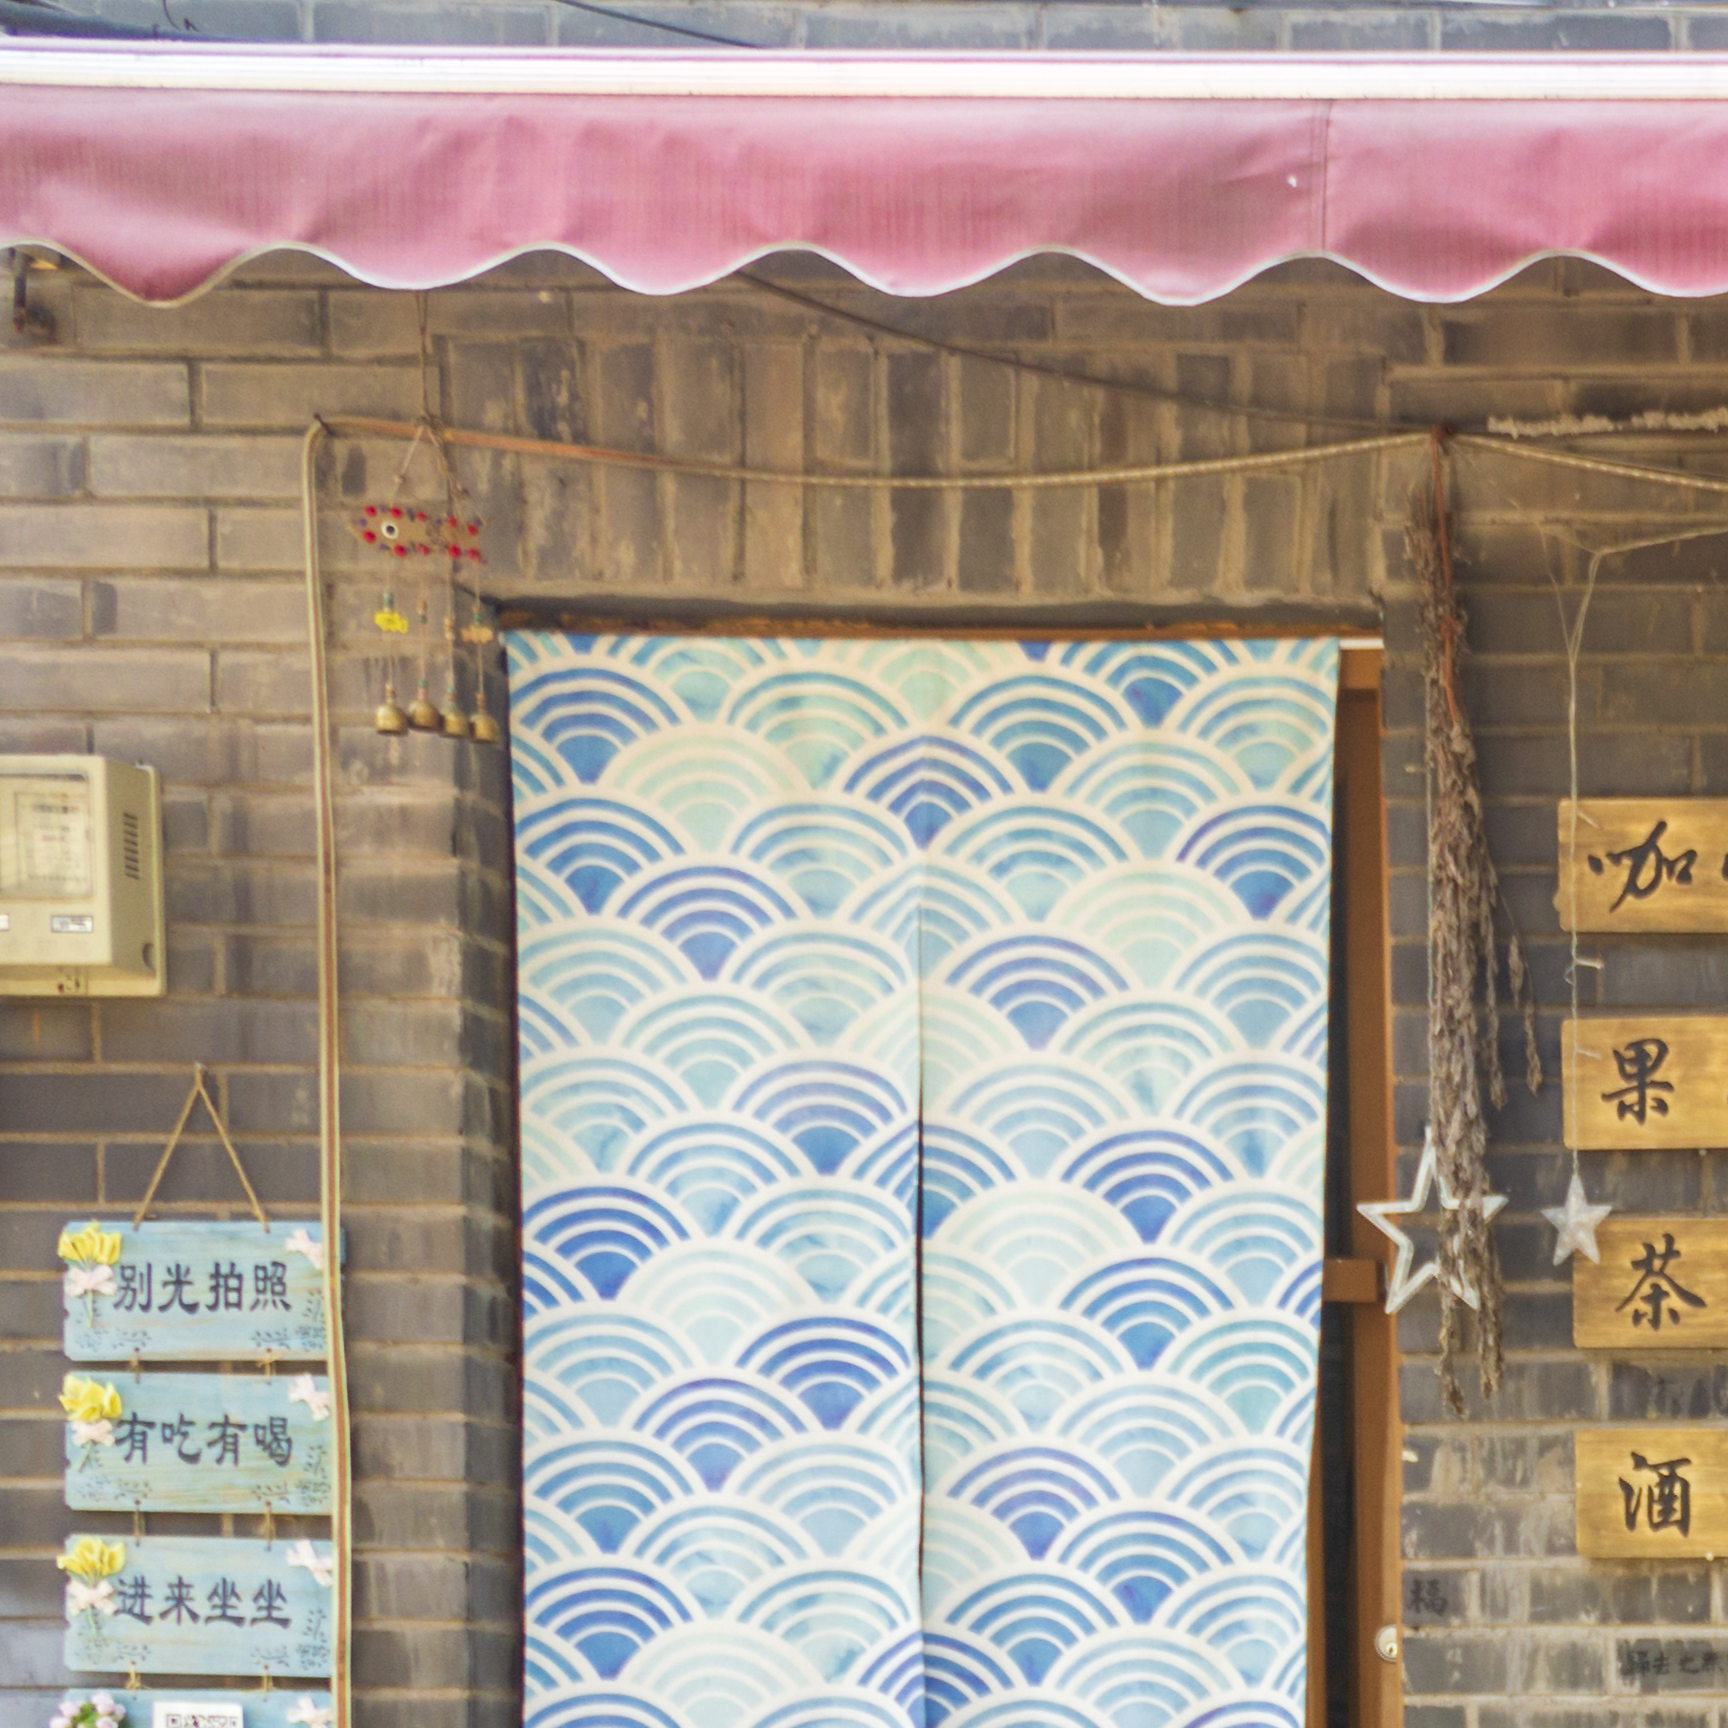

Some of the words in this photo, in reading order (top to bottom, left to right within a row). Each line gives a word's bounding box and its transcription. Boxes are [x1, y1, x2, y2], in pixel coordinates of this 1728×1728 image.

[114, 1260, 293, 1314] 别光拍照
[114, 1412, 293, 1467] 有吃有喝
[115, 1575, 293, 1627] 进来坐坐
